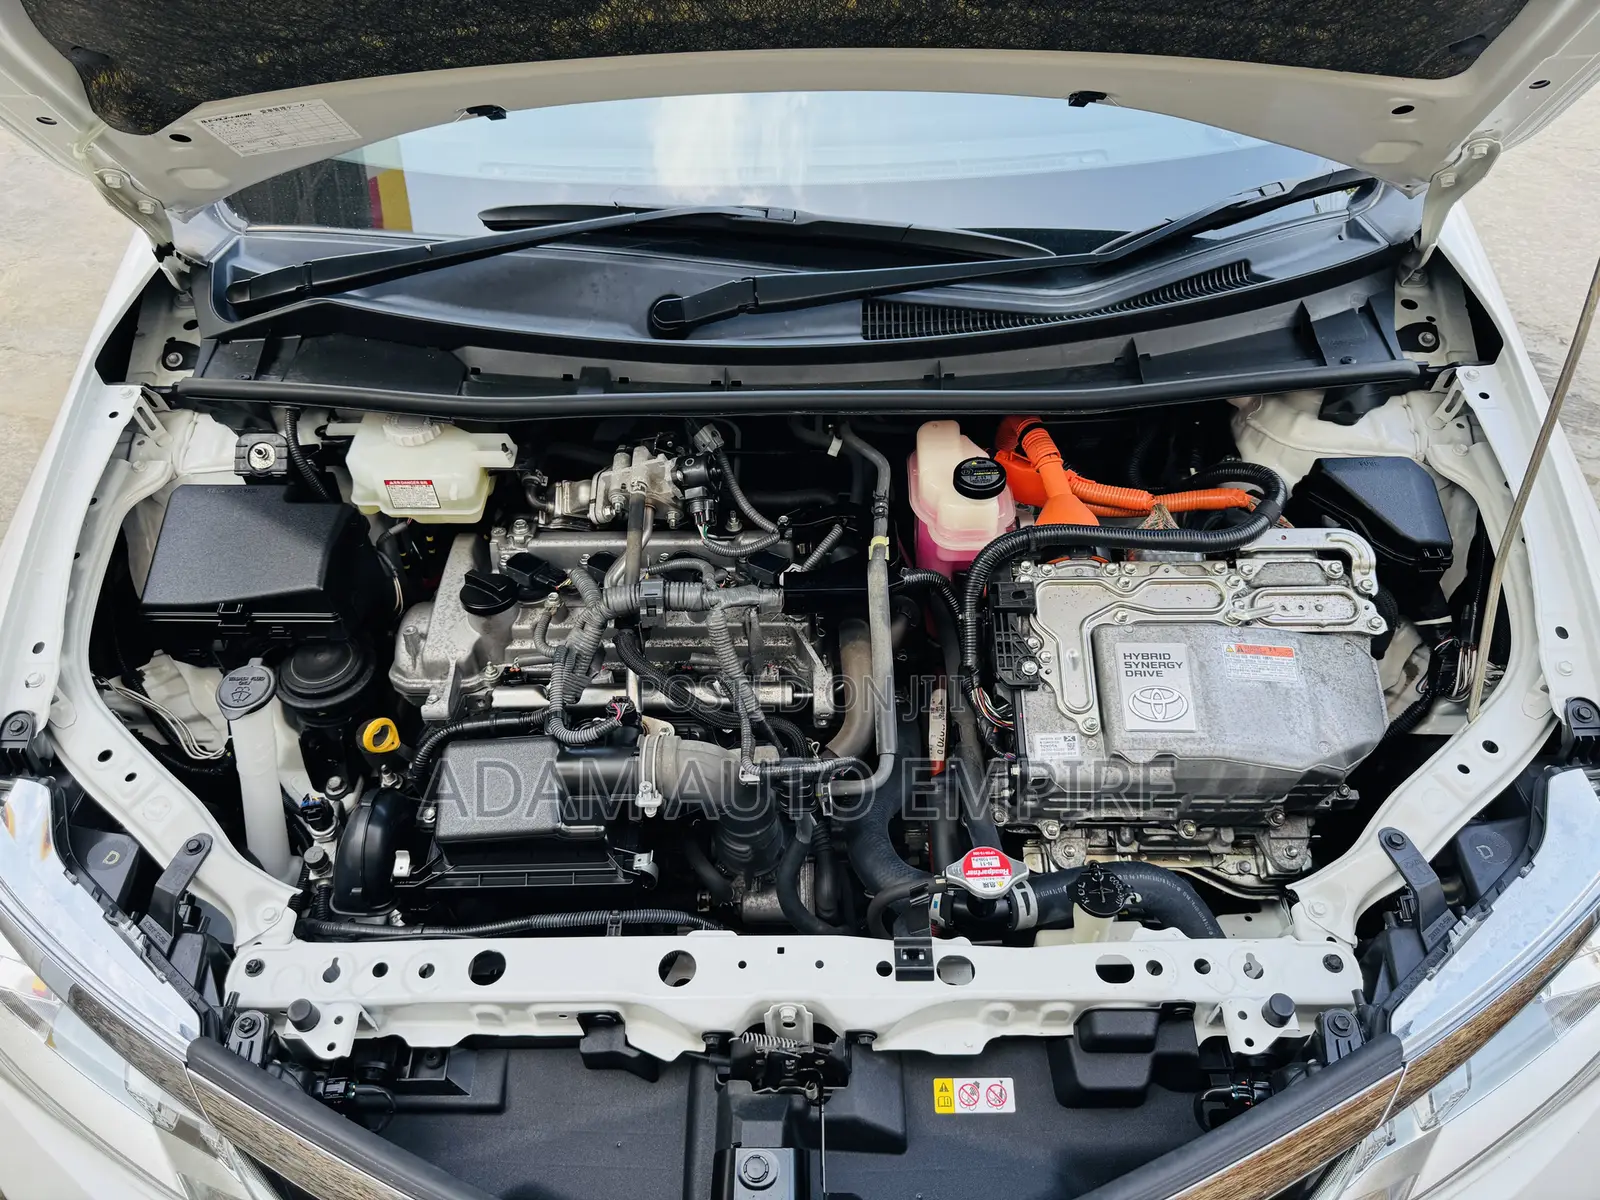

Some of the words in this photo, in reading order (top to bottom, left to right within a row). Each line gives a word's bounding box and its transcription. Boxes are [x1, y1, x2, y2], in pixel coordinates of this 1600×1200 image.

[1123, 652, 1171, 660] HYBRID
[1124, 661, 1183, 669] SYNERGY
[965, 868, 1010, 876] Roadpartner
